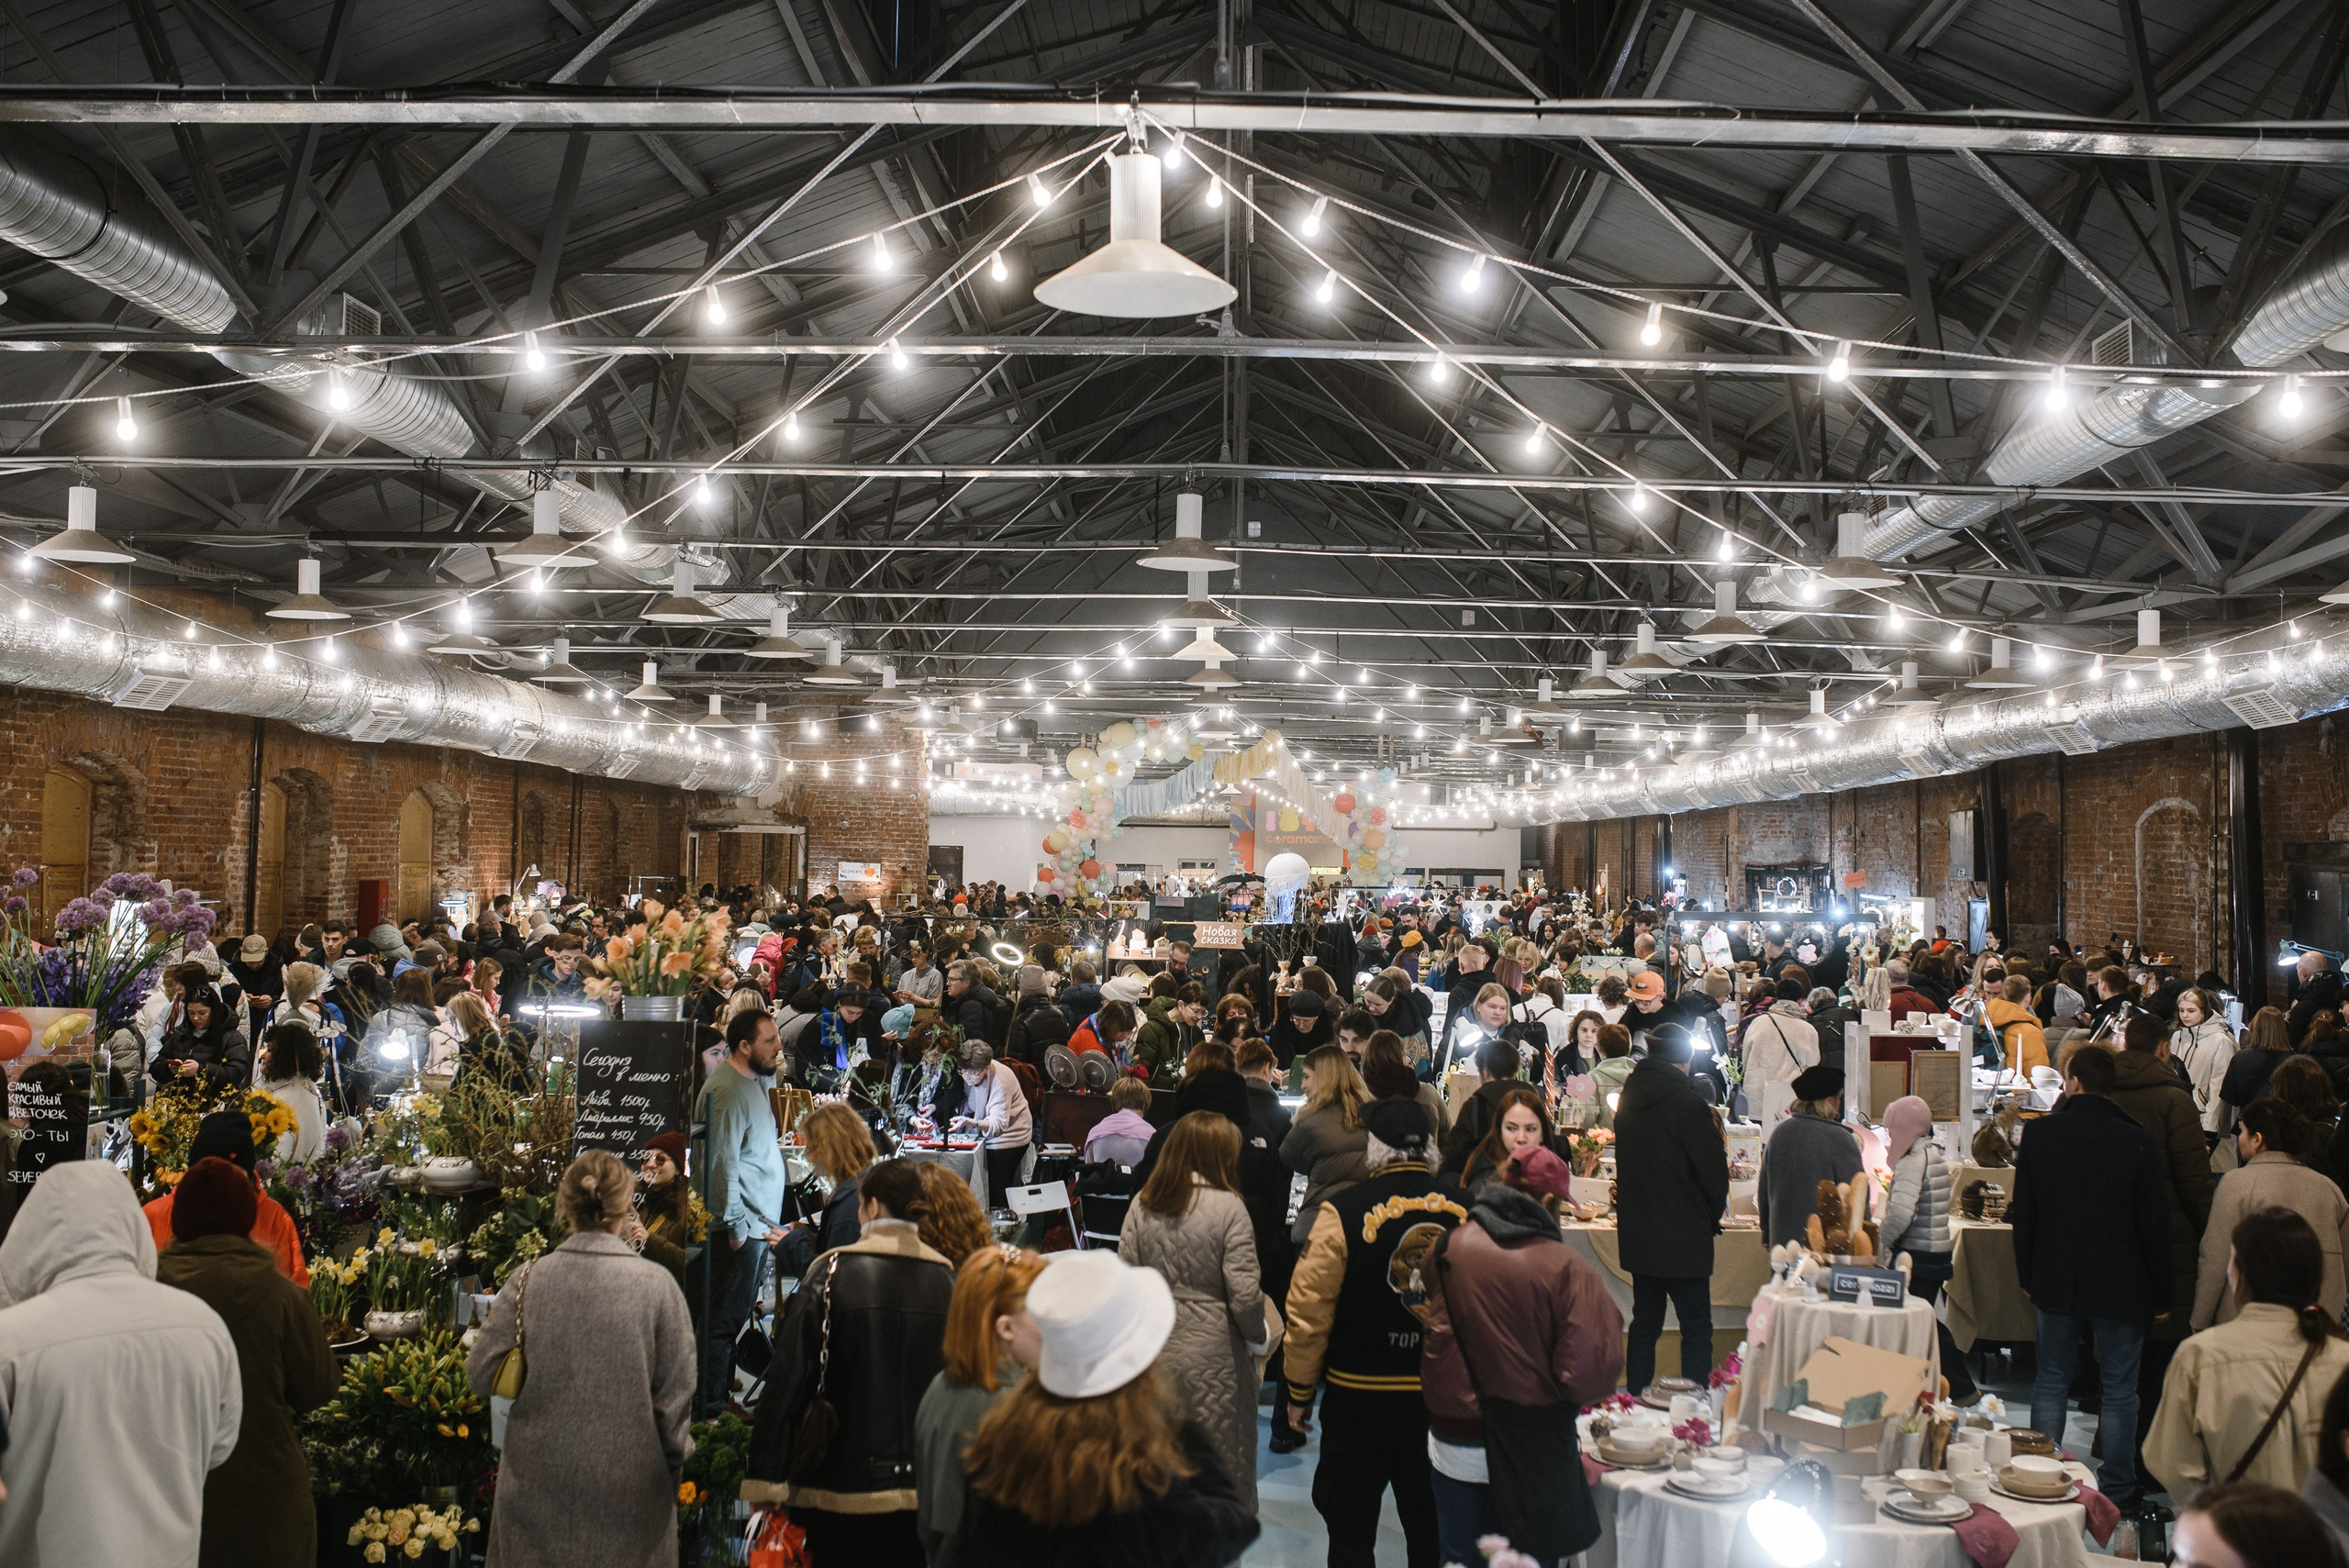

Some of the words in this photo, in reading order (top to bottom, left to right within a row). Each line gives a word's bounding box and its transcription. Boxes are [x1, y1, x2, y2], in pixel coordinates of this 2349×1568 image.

[1202, 925, 1238, 937] Новая
[1200, 936, 1238, 945] сказка
[583, 1047, 633, 1077] Сегодня
[615, 1066, 630, 1082] в
[7, 1080, 43, 1093] САМЫЙ
[7, 1093, 62, 1106] КРАСИВЫЙ
[46, 1129, 69, 1142] ТЫ
[573, 1126, 606, 1140] Тополь
[1840, 1279, 1896, 1294] cerozzi
[1387, 1331, 1420, 1348] TOP
